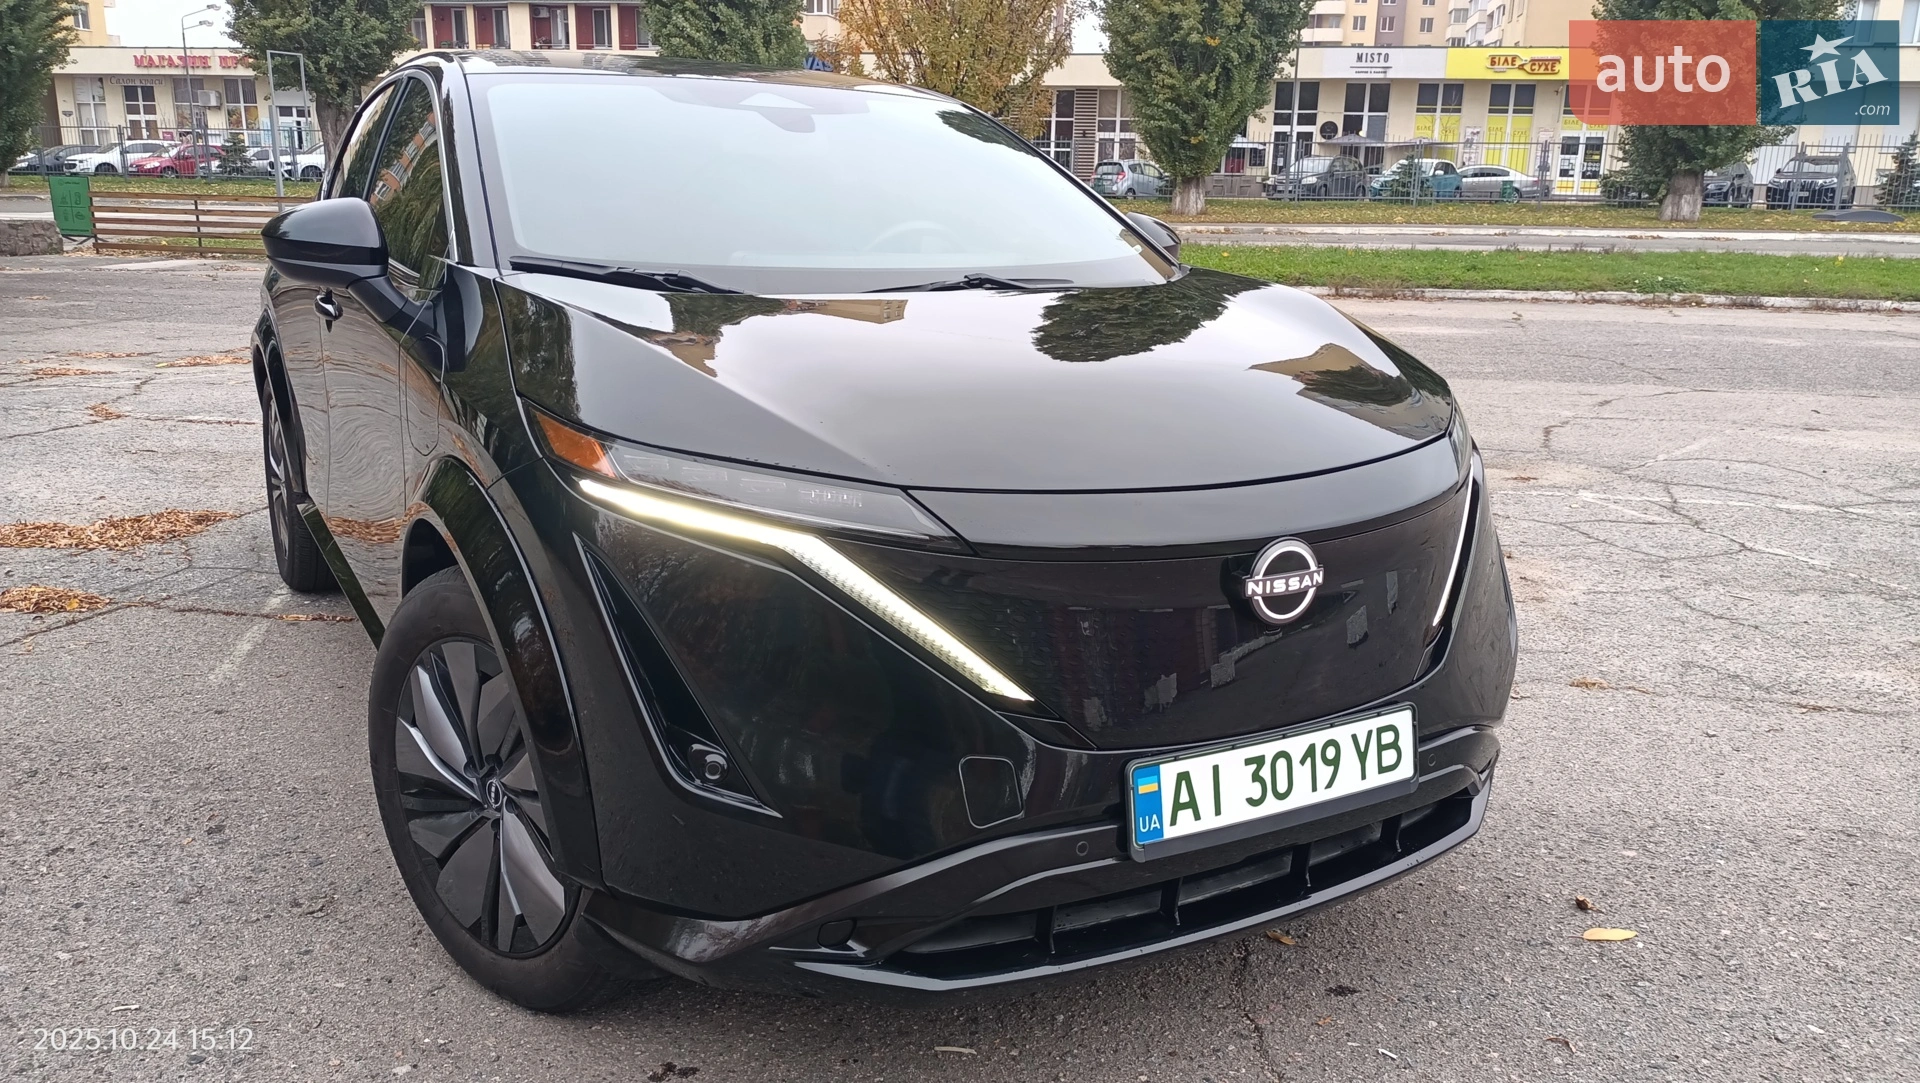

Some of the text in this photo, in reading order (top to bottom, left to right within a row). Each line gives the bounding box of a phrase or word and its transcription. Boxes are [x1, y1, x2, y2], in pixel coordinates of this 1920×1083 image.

[133, 54, 211, 68] МАГАЗИН
[1356, 52, 1390, 63] MISTO
[1490, 56, 1557, 72] БІЛЕ СУХЕ
[109, 75, 163, 86] Салон краси
[1247, 571, 1323, 595] NISSAN
[1169, 724, 1402, 827] AI 3019 YB
[1139, 813, 1161, 833] UA
